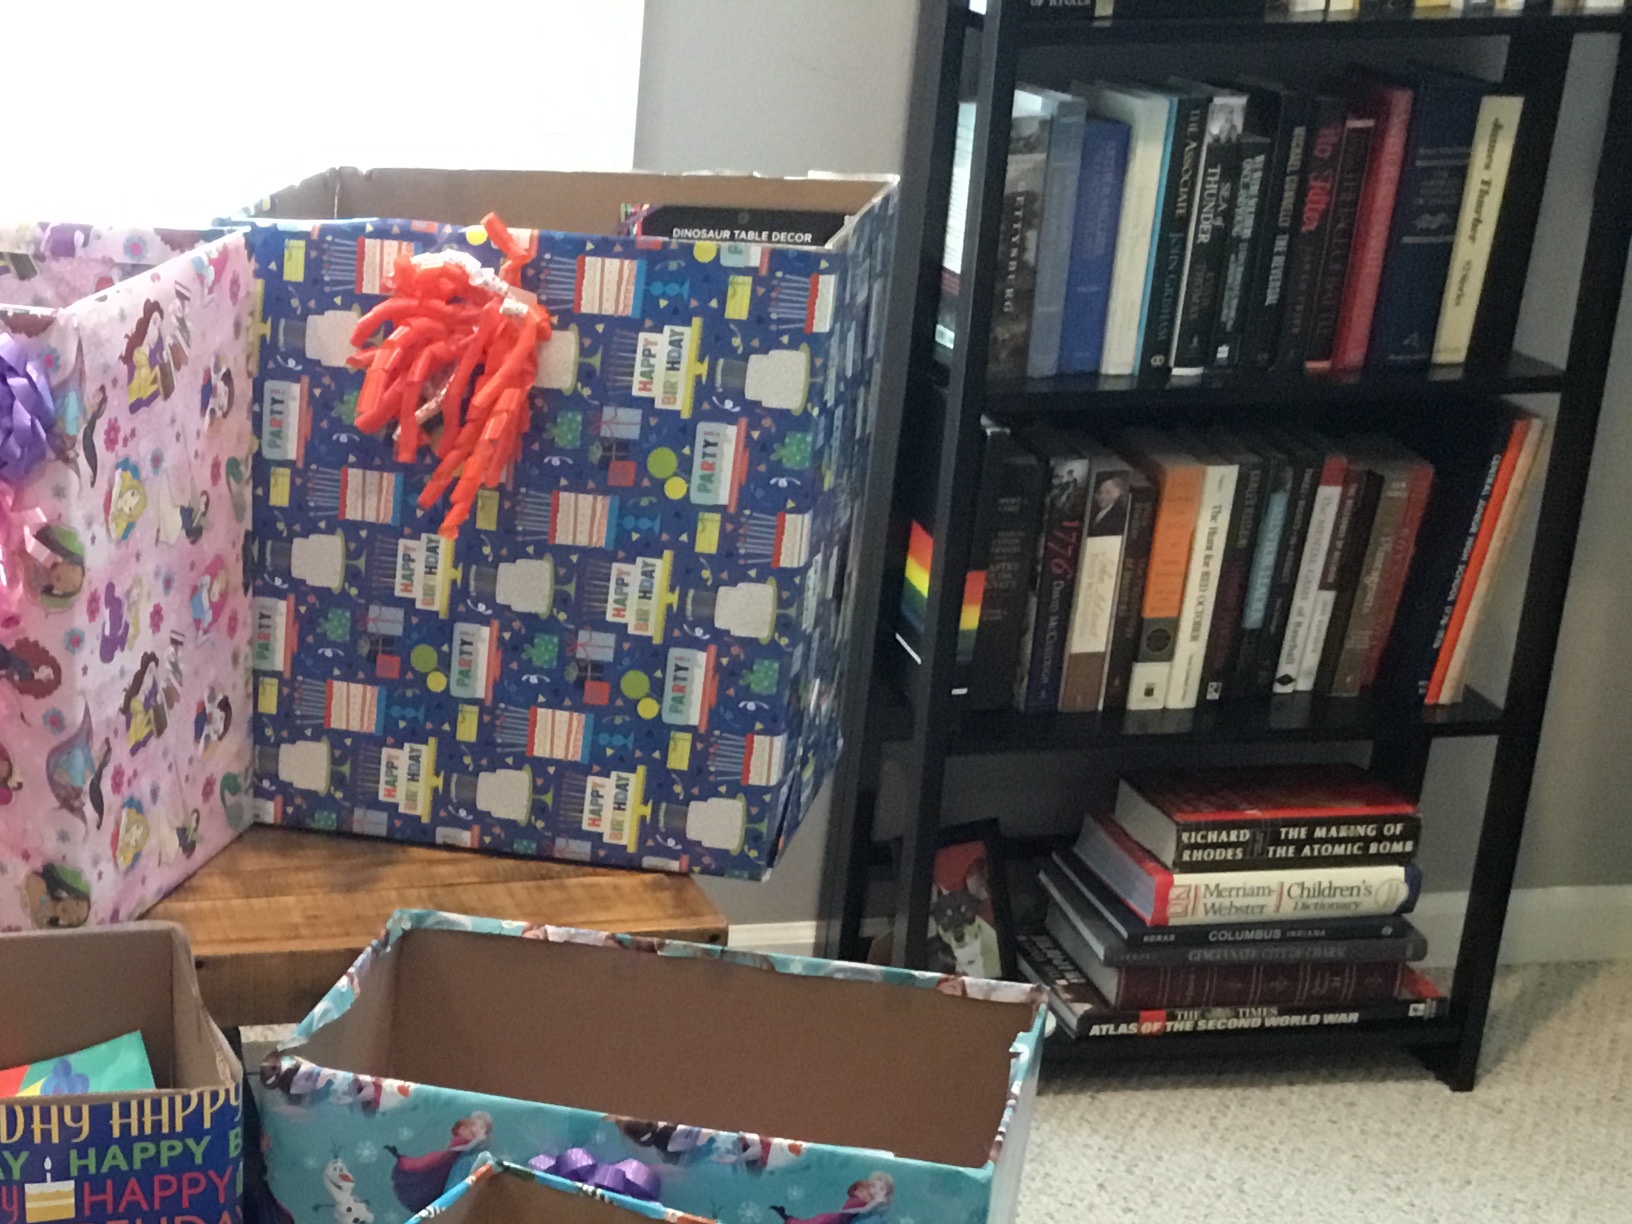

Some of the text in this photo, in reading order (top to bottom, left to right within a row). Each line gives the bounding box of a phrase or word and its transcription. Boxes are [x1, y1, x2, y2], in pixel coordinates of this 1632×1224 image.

[1468, 117, 1504, 244] James Thurber
[1197, 163, 1221, 244] THUNDER
[1216, 181, 1230, 216] SEA
[672, 227, 812, 243] DINOSAUR TABLE DECOR
[638, 337, 659, 393] HAPPY
[661, 327, 686, 406] BIRTHDAY
[1047, 520, 1081, 580] 1776
[1205, 526, 1219, 552] Hunt
[400, 543, 417, 593] HAPPY
[612, 567, 632, 619] HAPPY
[1197, 571, 1212, 597] RED
[1188, 598, 1207, 643] OCTOBER
[1285, 619, 1303, 665] Baseball
[382, 750, 400, 799] HAPPY
[587, 780, 607, 829] HAPPY
[1182, 829, 1250, 844] RICHARD
[1280, 823, 1405, 840] THE MAKING OF
[1182, 847, 1244, 862] RHODES
[1268, 840, 1415, 858] THE ATOMIC BOMB
[1203, 882, 1276, 900] Merriam-
[1286, 879, 1373, 900] Children's
[1203, 901, 1267, 916] Webster
[1292, 900, 1363, 914] Dictionary
[1208, 928, 1281, 943] COLUMBUS
[1089, 1012, 1359, 1037] ATLAS OF THE SECOND WORLD WAR
[1175, 1007, 1278, 1022] THE TIMES
[70, 1135, 212, 1178] HAPPY
[83, 1165, 234, 1217] HAPPY
